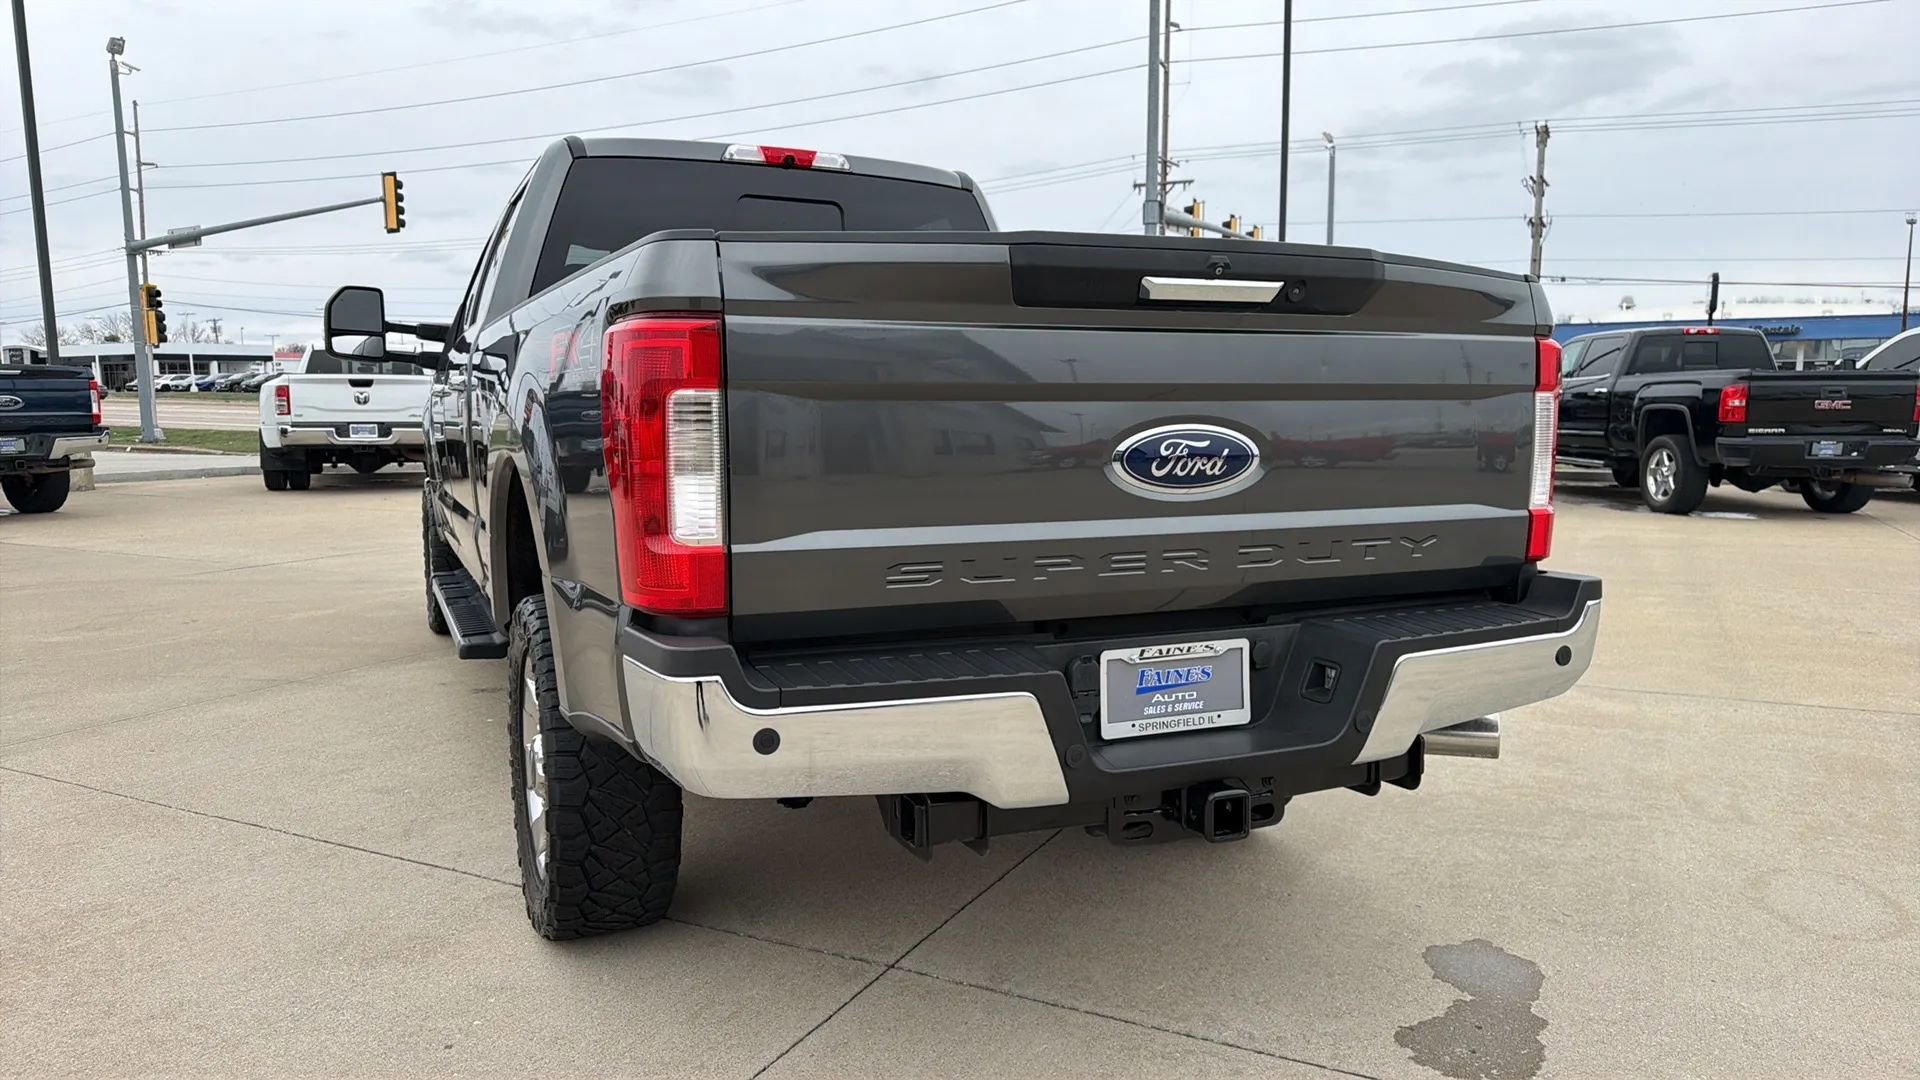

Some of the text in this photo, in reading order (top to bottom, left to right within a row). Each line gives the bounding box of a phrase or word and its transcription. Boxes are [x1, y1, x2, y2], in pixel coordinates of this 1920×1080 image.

[549, 322, 597, 381] FX4
[1815, 400, 1852, 409] GMC
[1151, 438, 1228, 477] Ford
[885, 534, 1438, 589] SUPER DUTY
[1139, 644, 1214, 657] FAINE'S
[1136, 665, 1213, 688] FAINE'S
[1151, 691, 1197, 703] AUTO
[1143, 704, 1166, 715] SALES
[1174, 701, 1204, 712] SERVICE
[1138, 715, 1217, 732] SPRINGFIELD IL
